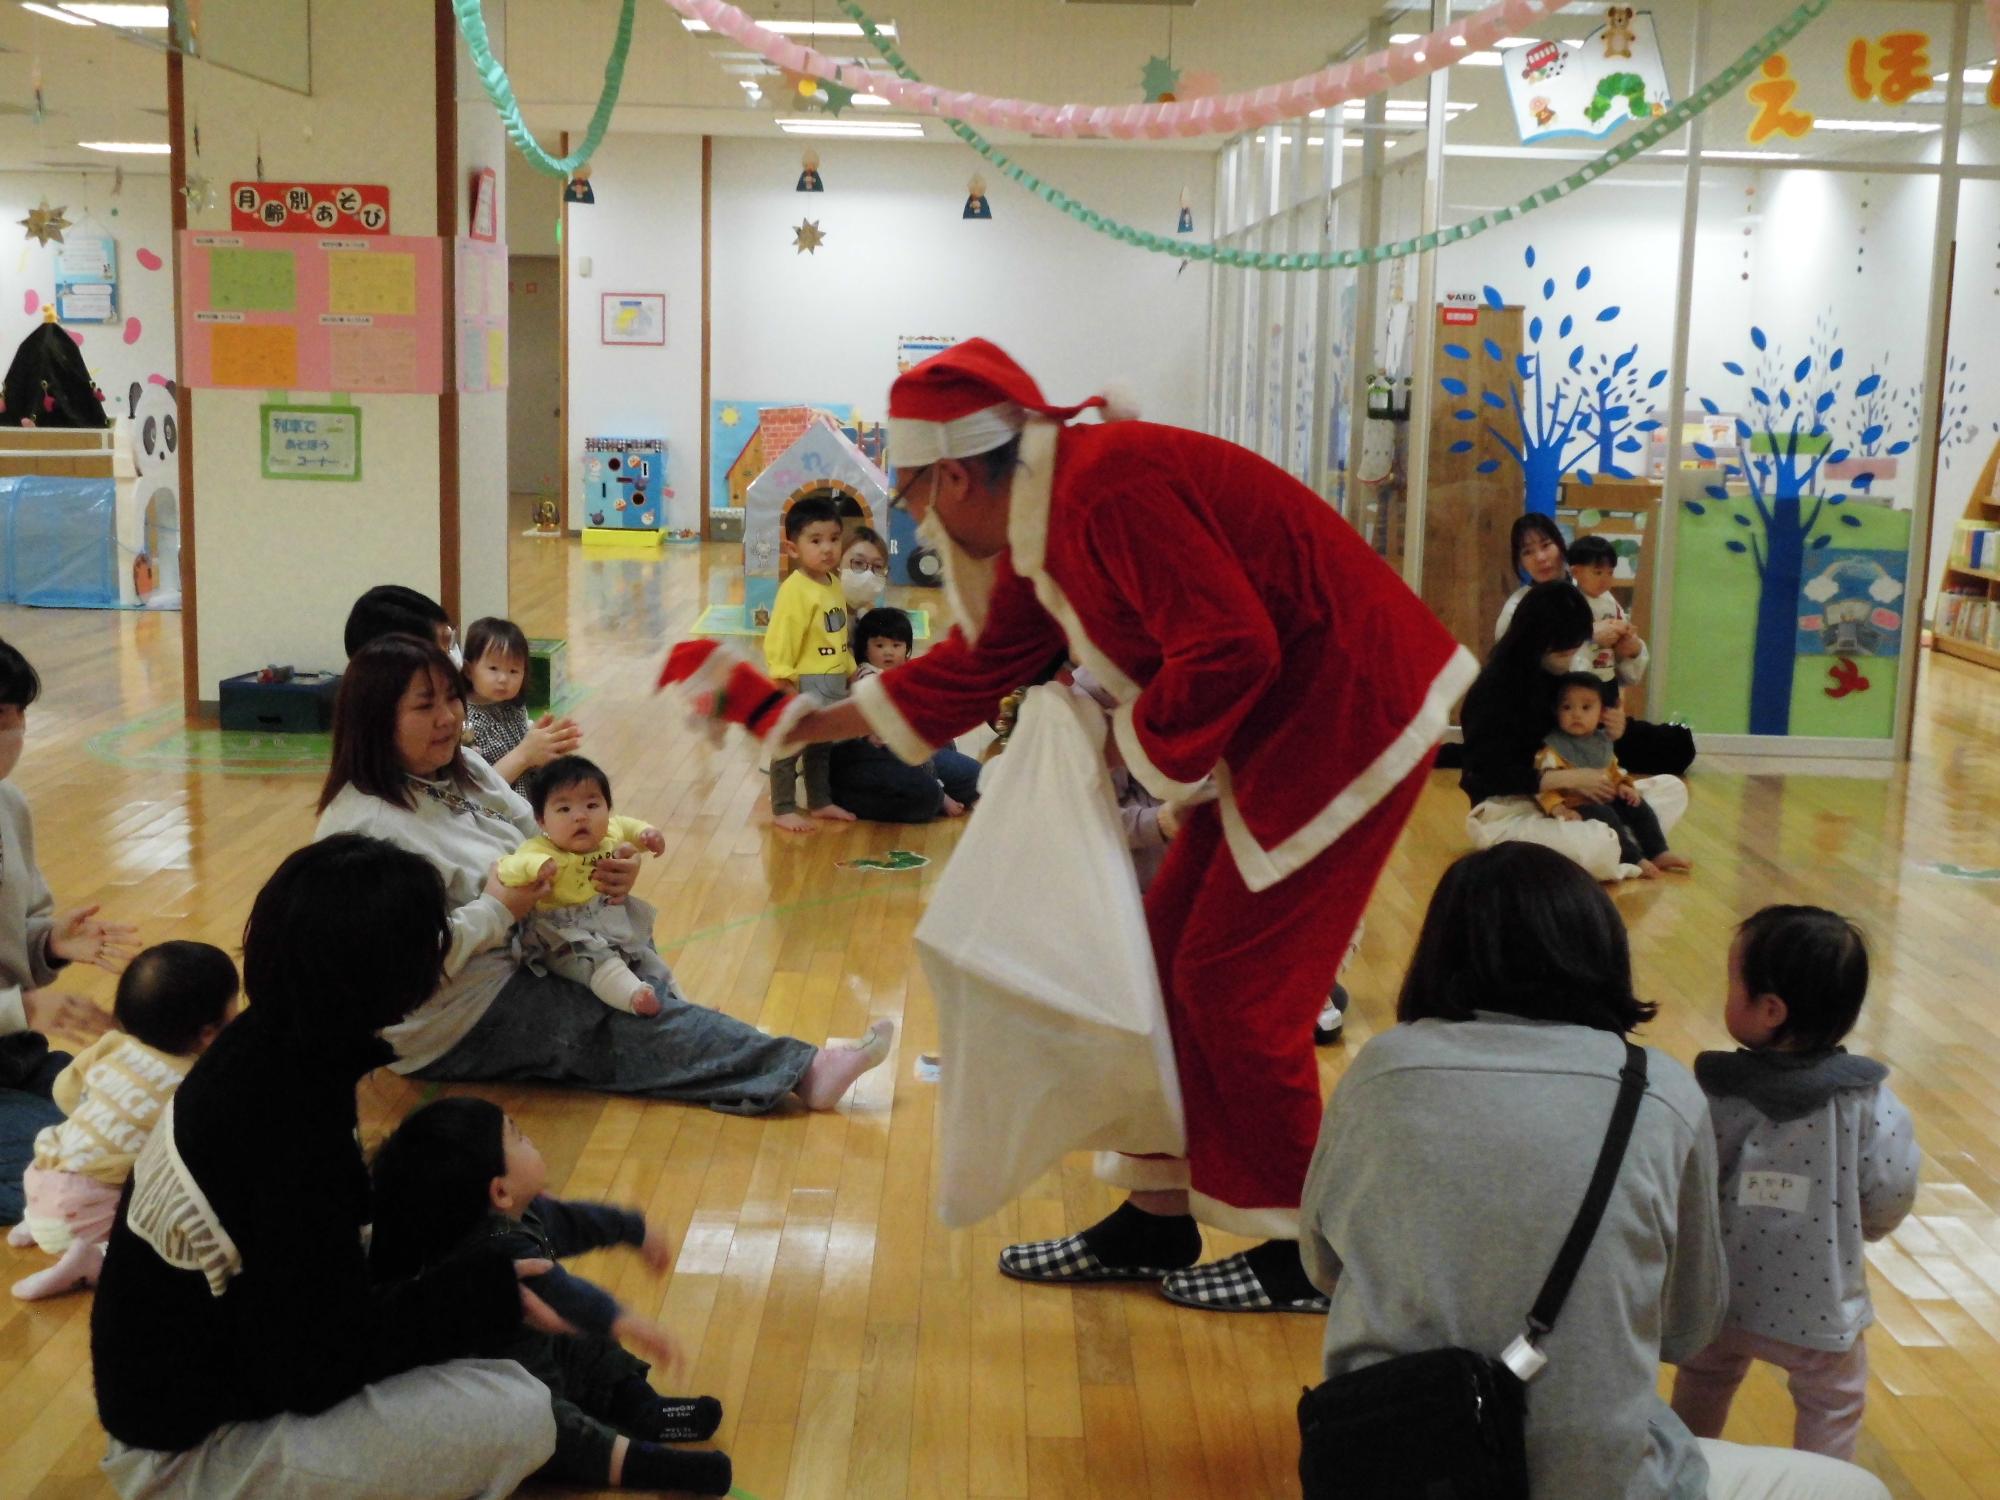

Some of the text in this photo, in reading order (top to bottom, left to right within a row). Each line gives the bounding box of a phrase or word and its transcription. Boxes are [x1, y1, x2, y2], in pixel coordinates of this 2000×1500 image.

[1748, 33, 2000, 143] えほ
[238, 189, 382, 228] 月齢別あそび
